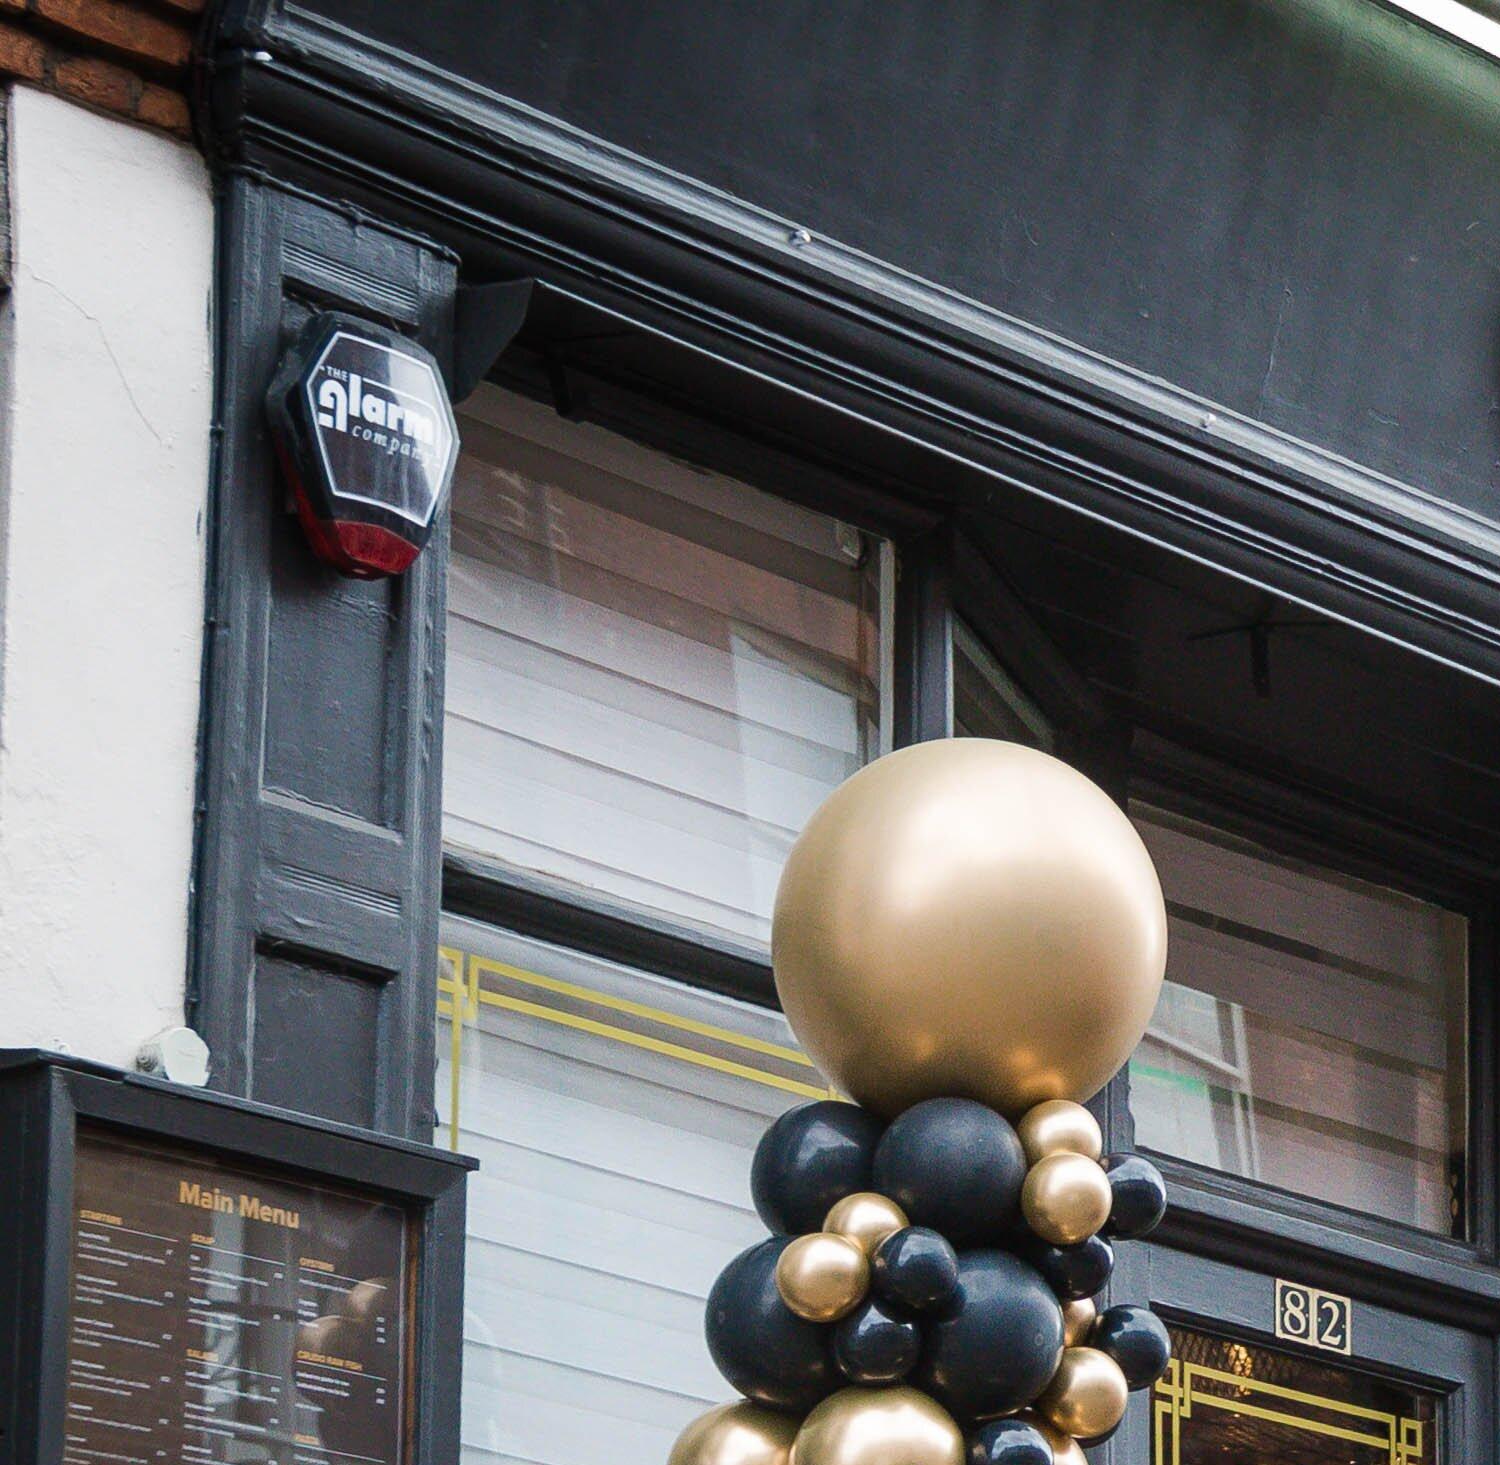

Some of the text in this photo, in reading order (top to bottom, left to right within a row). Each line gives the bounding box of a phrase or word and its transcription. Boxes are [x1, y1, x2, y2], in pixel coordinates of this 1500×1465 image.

[326, 365, 349, 382] THE
[178, 1179, 300, 1229] Main Menu
[1283, 1290, 1342, 1346] 82
